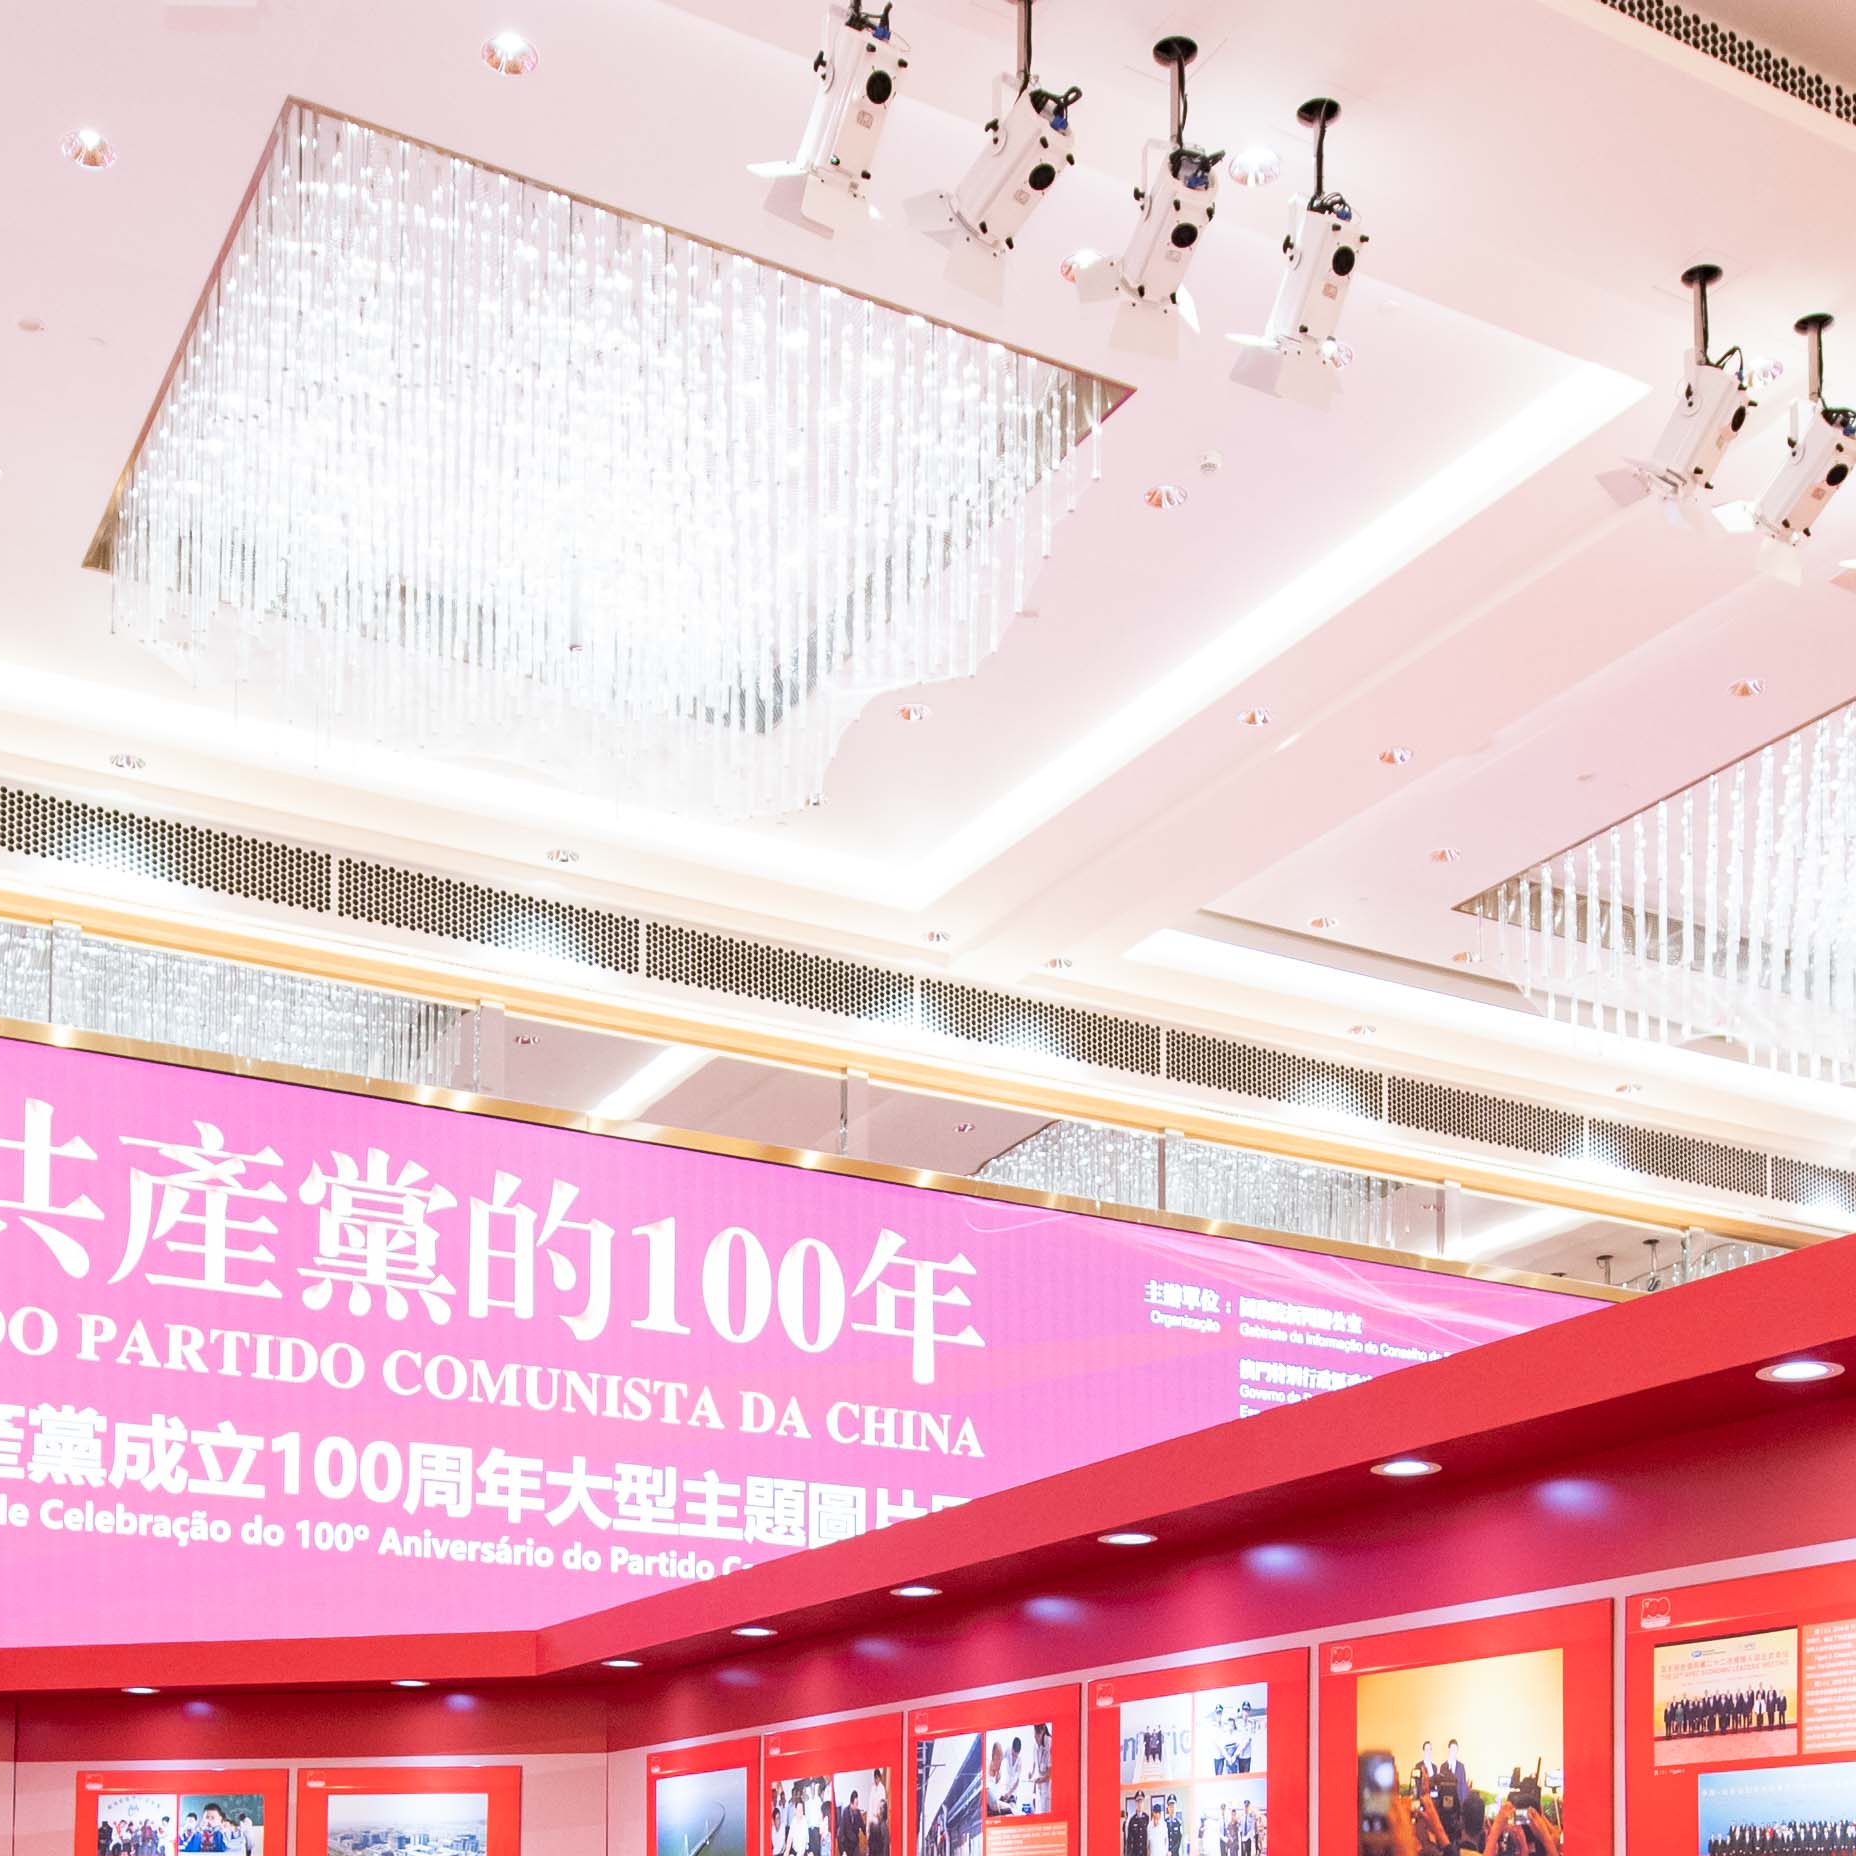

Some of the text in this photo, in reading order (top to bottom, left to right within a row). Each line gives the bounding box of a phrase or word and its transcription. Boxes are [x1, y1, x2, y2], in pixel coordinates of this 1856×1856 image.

[76, 1313, 365, 1389] PARTIDO
[382, 1349, 725, 1429] COMUNISTA
[739, 1391, 812, 1439] DA
[826, 1401, 985, 1458] CHINA
[39, 1498, 232, 1547] Celebração
[240, 1515, 285, 1547] do
[377, 1527, 554, 1568] Aniversário
[562, 1544, 602, 1572] do
[610, 1547, 715, 1580] Partido
